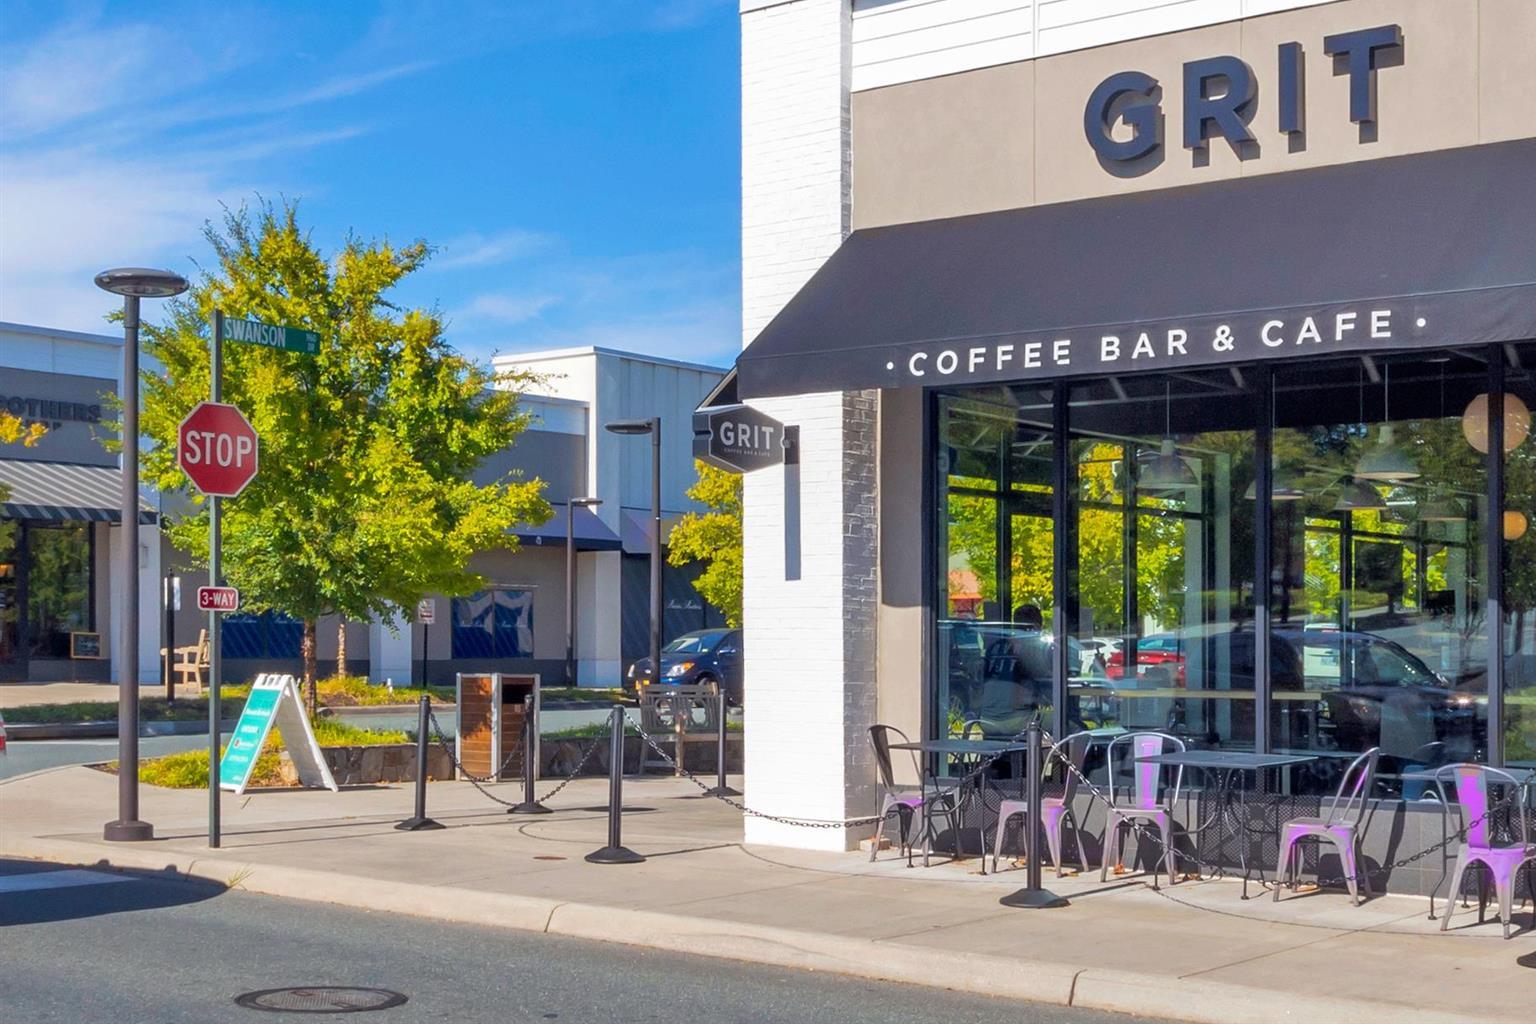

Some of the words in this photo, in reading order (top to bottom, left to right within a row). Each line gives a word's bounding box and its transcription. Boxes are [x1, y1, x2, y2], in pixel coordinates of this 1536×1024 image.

[1084, 24, 1403, 163] GRIT
[224, 318, 286, 349] SWANSON
[908, 339, 1072, 377] COFFEE
[1101, 328, 1188, 362] BAR
[1212, 324, 1236, 352] &
[1260, 309, 1392, 348] CAFE
[184, 430, 252, 468] STOP
[720, 421, 774, 450] GRIT
[202, 591, 235, 606] 3-WAY
